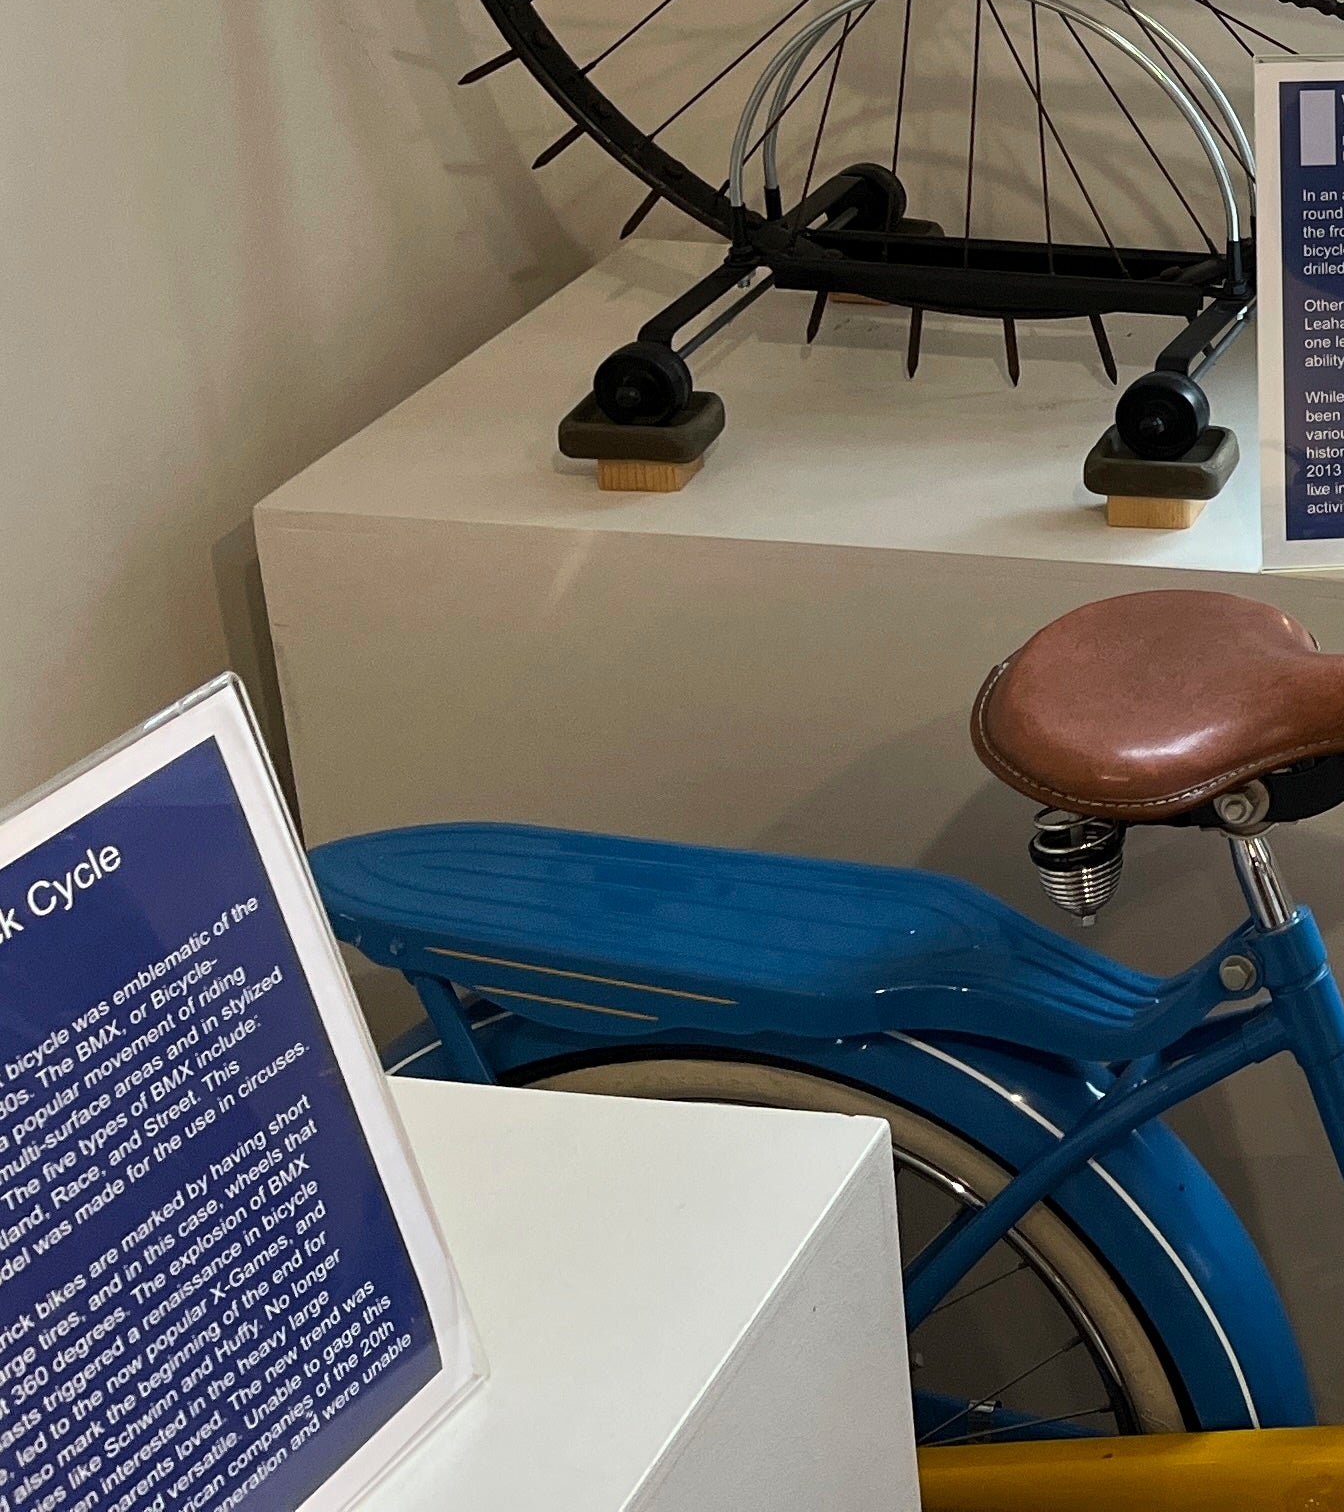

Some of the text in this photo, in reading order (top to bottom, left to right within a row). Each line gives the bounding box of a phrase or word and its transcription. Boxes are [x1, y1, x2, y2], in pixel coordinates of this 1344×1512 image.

[1302, 189, 1316, 202] In
[1319, 190, 1338, 202] an
[1302, 206, 1344, 221] round
[1302, 225, 1326, 239] the
[26, 845, 121, 917] Cycle
[4, 1028, 70, 1081] bicycle
[71, 1000, 111, 1033] was
[112, 930, 211, 1006] emblematic
[212, 911, 230, 936] of
[230, 897, 259, 923] the
[11, 1081, 80, 1146] popular
[83, 1012, 177, 1089] movement
[177, 995, 196, 1021] of
[198, 966, 246, 1008] riding
[34, 1057, 75, 1089] The
[75, 1018, 127, 1063] BMX,
[129, 1002, 148, 1025] or
[150, 958, 218, 1010] Bicycle-
[0, 965, 283, 1187] multi-surface areas and in stylized
[0, 1014, 261, 1211] The five types of BMX include:
[31, 1219, 73, 1255] was
[74, 1178, 125, 1225] made
[126, 1155, 150, 1184] for
[152, 1134, 182, 1163] the
[184, 1108, 217, 1139] use
[216, 1094, 236, 1114] in
[237, 1042, 310, 1098] circuses.
[50, 1060, 240, 1210] Race, and Street. This
